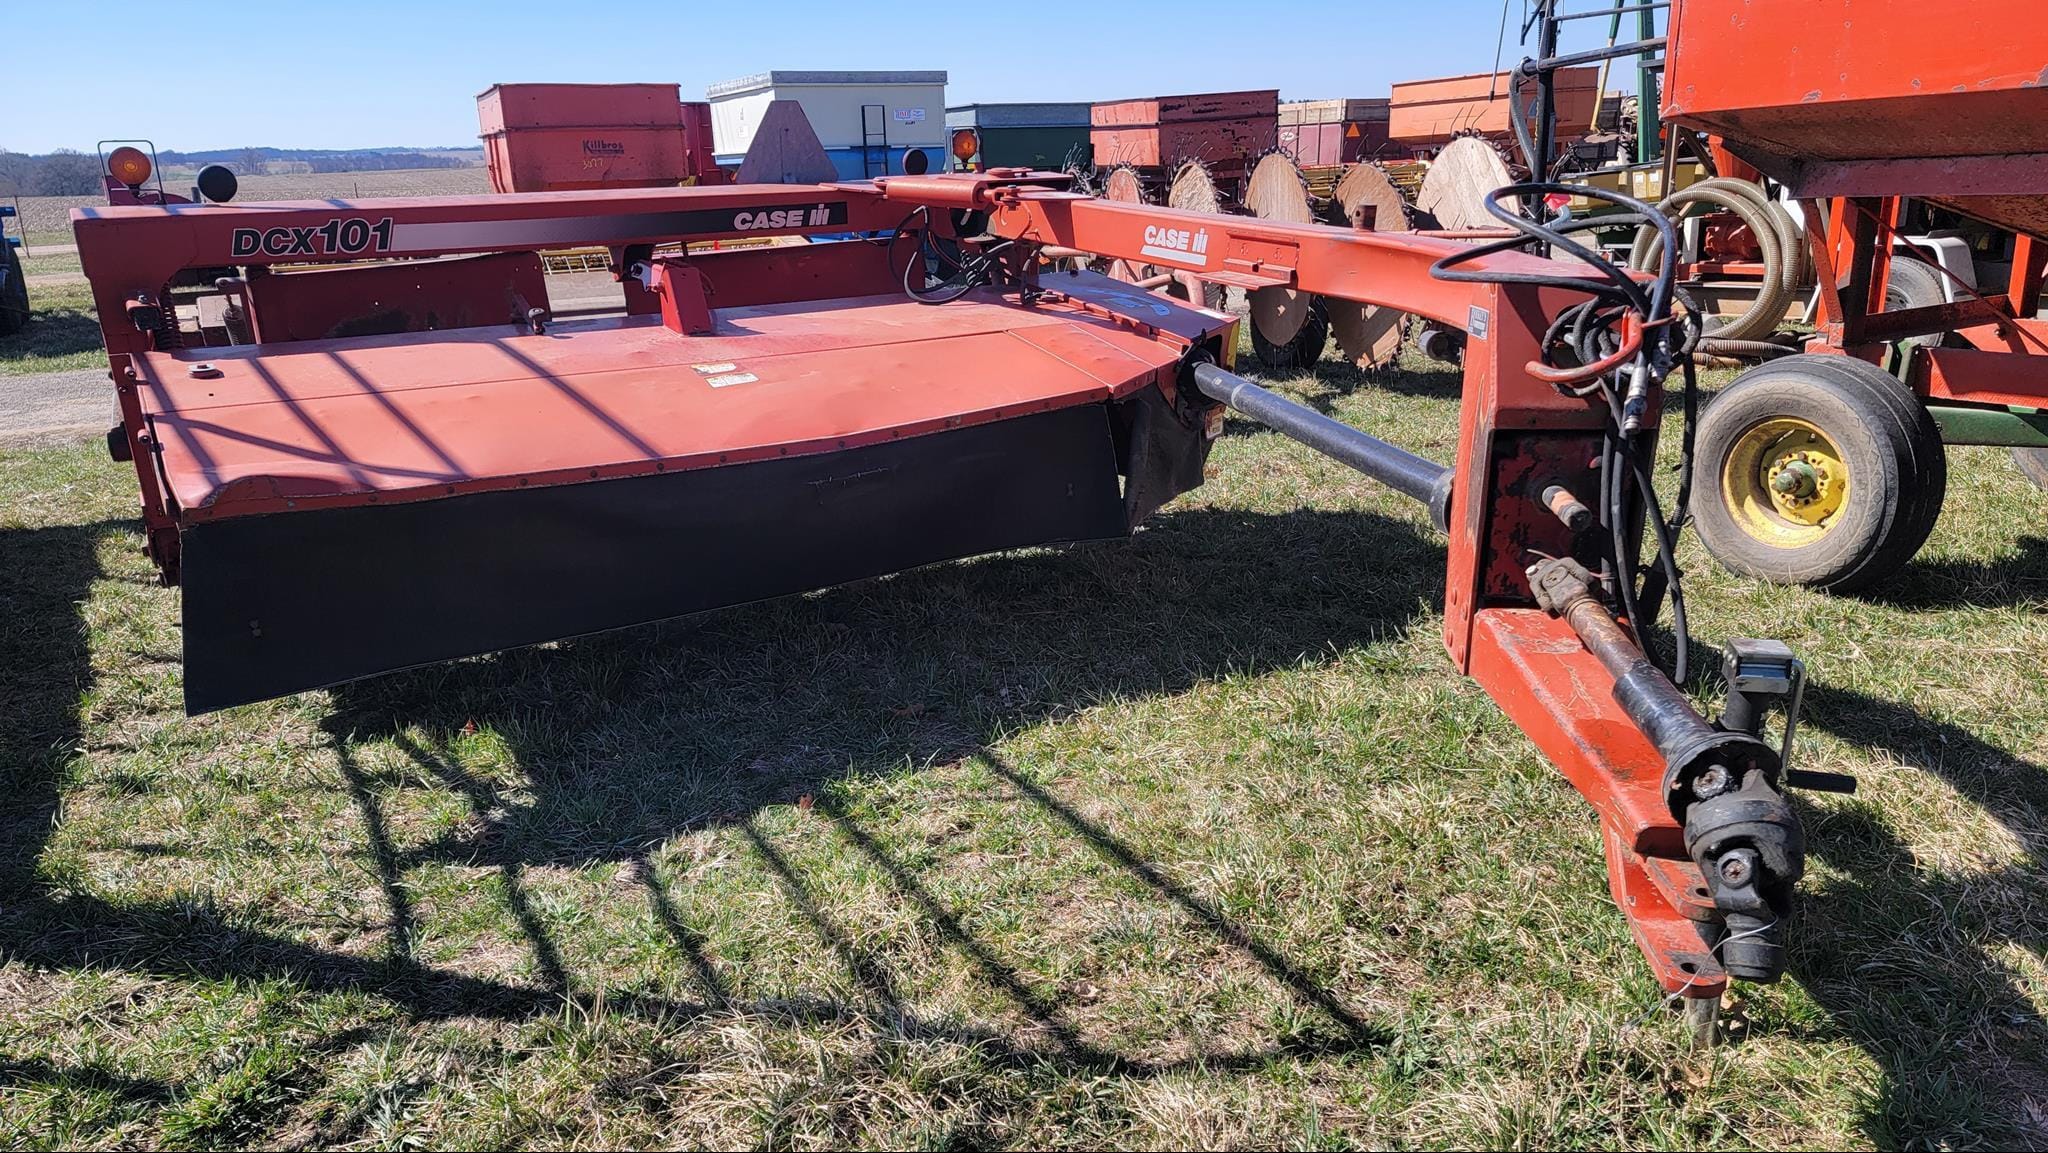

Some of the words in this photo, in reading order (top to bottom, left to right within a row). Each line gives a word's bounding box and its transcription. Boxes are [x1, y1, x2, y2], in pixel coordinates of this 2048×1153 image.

[734, 209, 804, 230] CASE
[231, 217, 393, 257] DCX101
[1144, 225, 1190, 250] CASE
